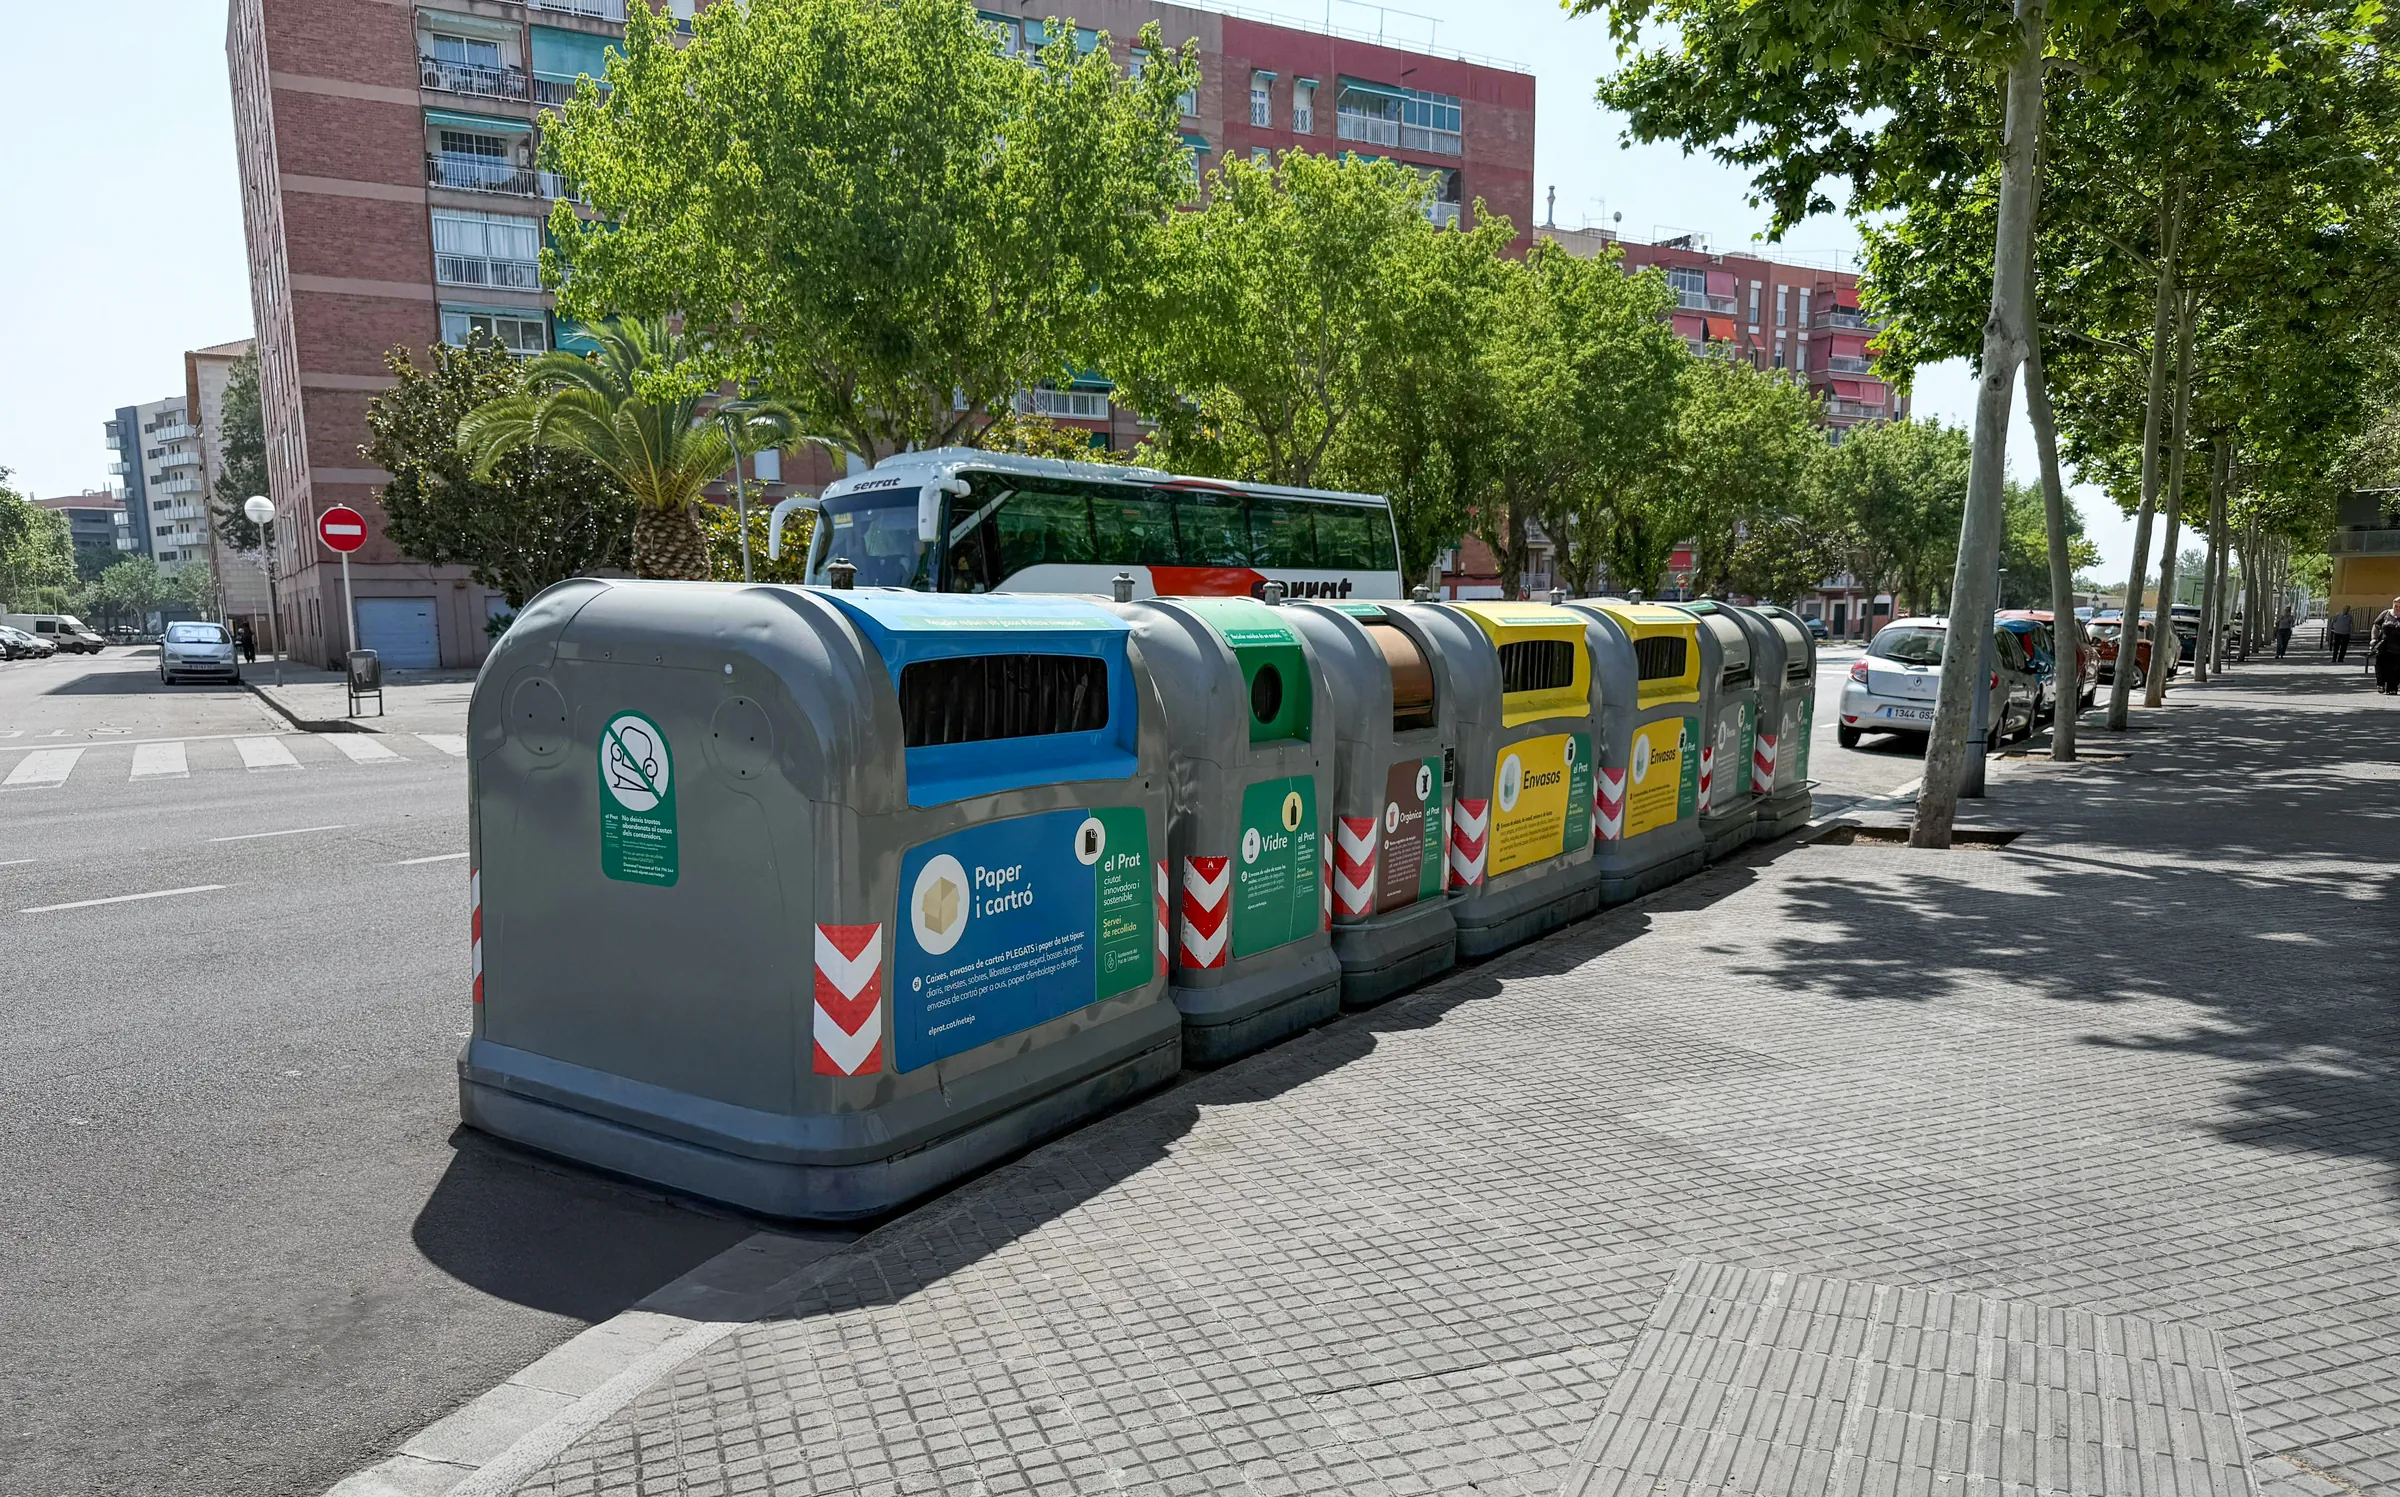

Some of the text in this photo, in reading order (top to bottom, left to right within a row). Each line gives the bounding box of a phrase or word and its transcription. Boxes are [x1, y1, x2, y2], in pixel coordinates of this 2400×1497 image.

[852, 477, 901, 492] serrat
[1895, 709, 1915, 718] 1344
[1650, 748, 1676, 765] Envasos
[1523, 770, 1561, 790] Envasos
[1400, 809, 1423, 824] Orgànica
[1262, 832, 1288, 853] Vidre
[1297, 832, 1315, 843] el Prat
[1104, 853, 1141, 872] el Prat
[975, 863, 1022, 891] Paper
[1103, 874, 1121, 885] ciutat
[1103, 882, 1137, 896] innovadora
[976, 883, 1033, 919] i cartró
[1103, 892, 1133, 907] sostenible
[1103, 915, 1122, 928] Servei
[1103, 922, 1137, 938] de recollida
[926, 973, 949, 985] Caixes,
[949, 964, 975, 977] envasos
[976, 959, 984, 969] de
[985, 952, 1005, 966] cartró
[1005, 943, 1035, 960] PLEGATS
[1038, 940, 1054, 953] paper
[1054, 936, 1061, 946] de
[1061, 934, 1069, 944] tot
[1012, 961, 1029, 972] sense
[927, 996, 951, 1012] envasos
[951, 992, 960, 1004] de
[960, 986, 978, 1000] cartró
[979, 985, 989, 997] per
[1007, 973, 1026, 988] paper
[928, 1014, 976, 1037] elprat.cat/neteja
